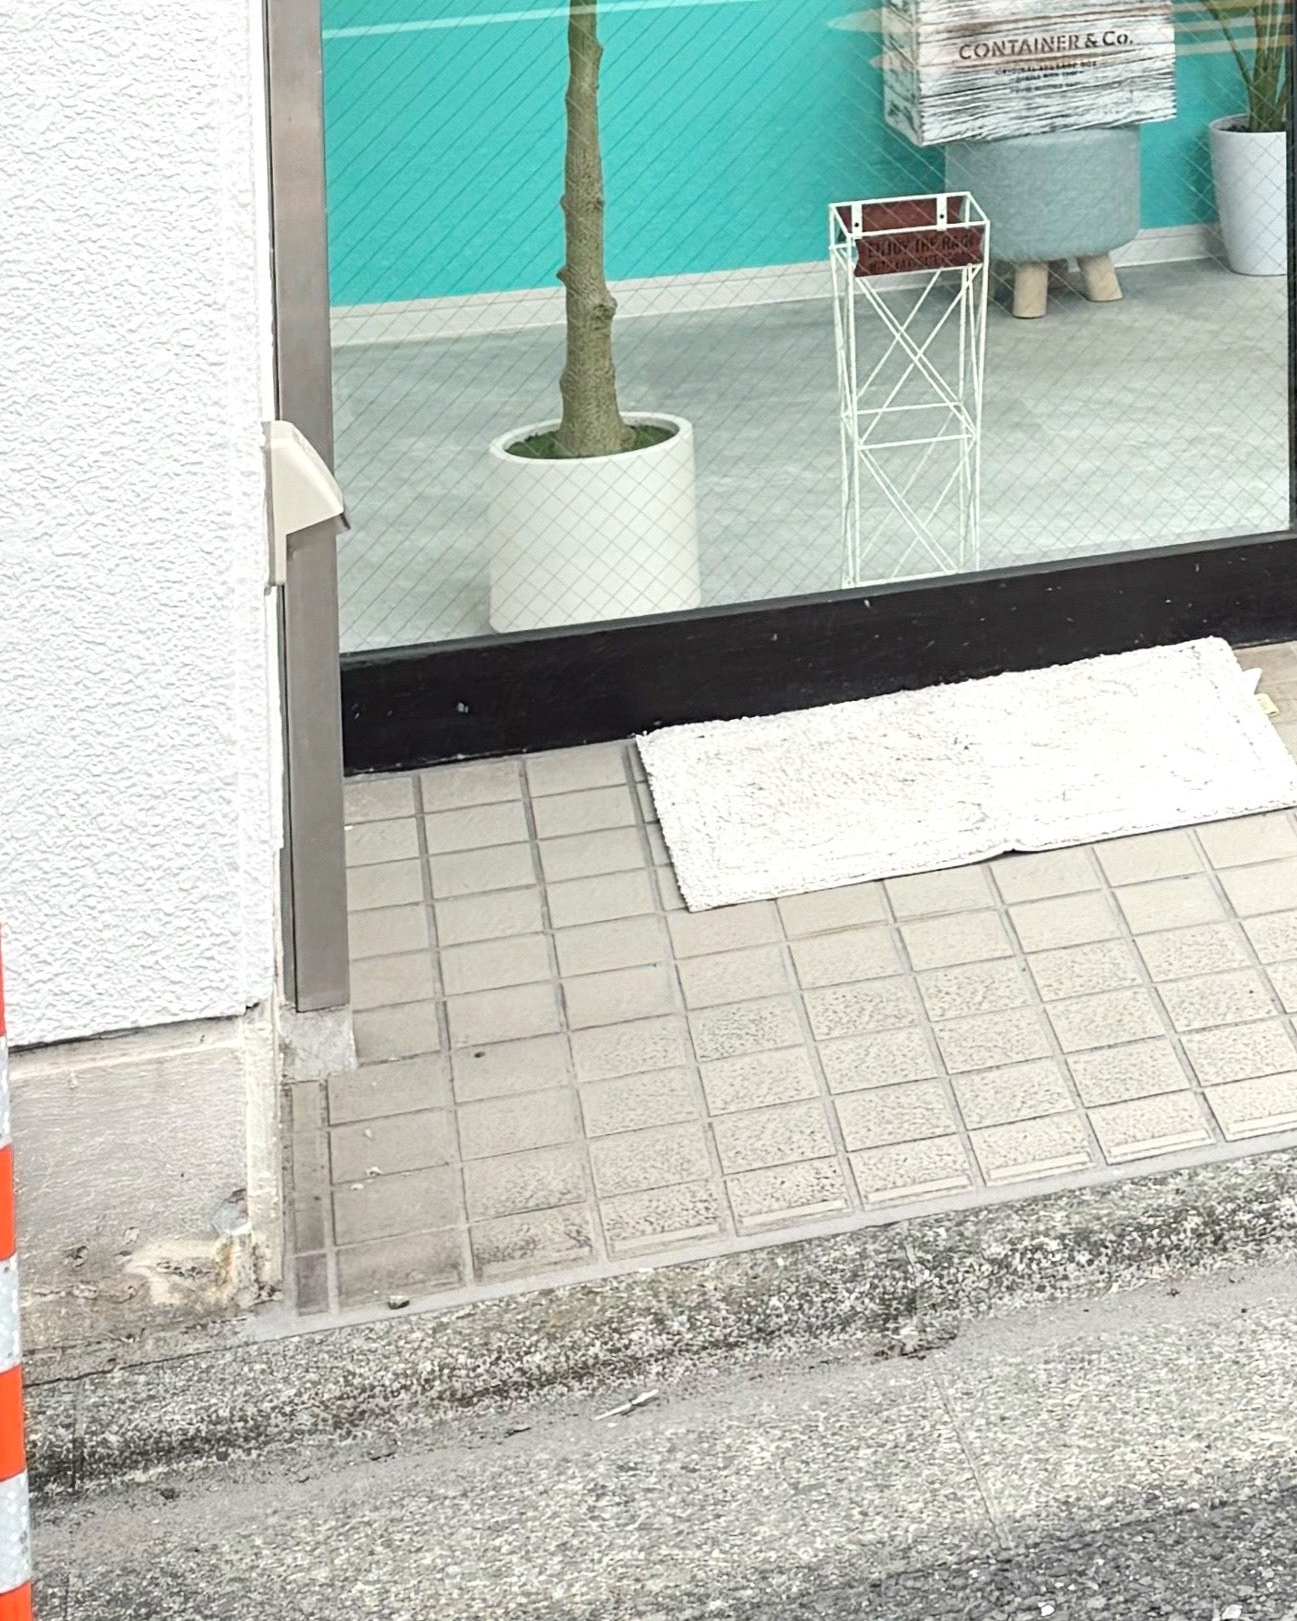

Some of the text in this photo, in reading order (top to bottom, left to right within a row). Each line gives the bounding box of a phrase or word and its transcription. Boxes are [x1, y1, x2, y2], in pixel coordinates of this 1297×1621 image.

[958, 30, 1134, 60] CONTAINER & Co.
